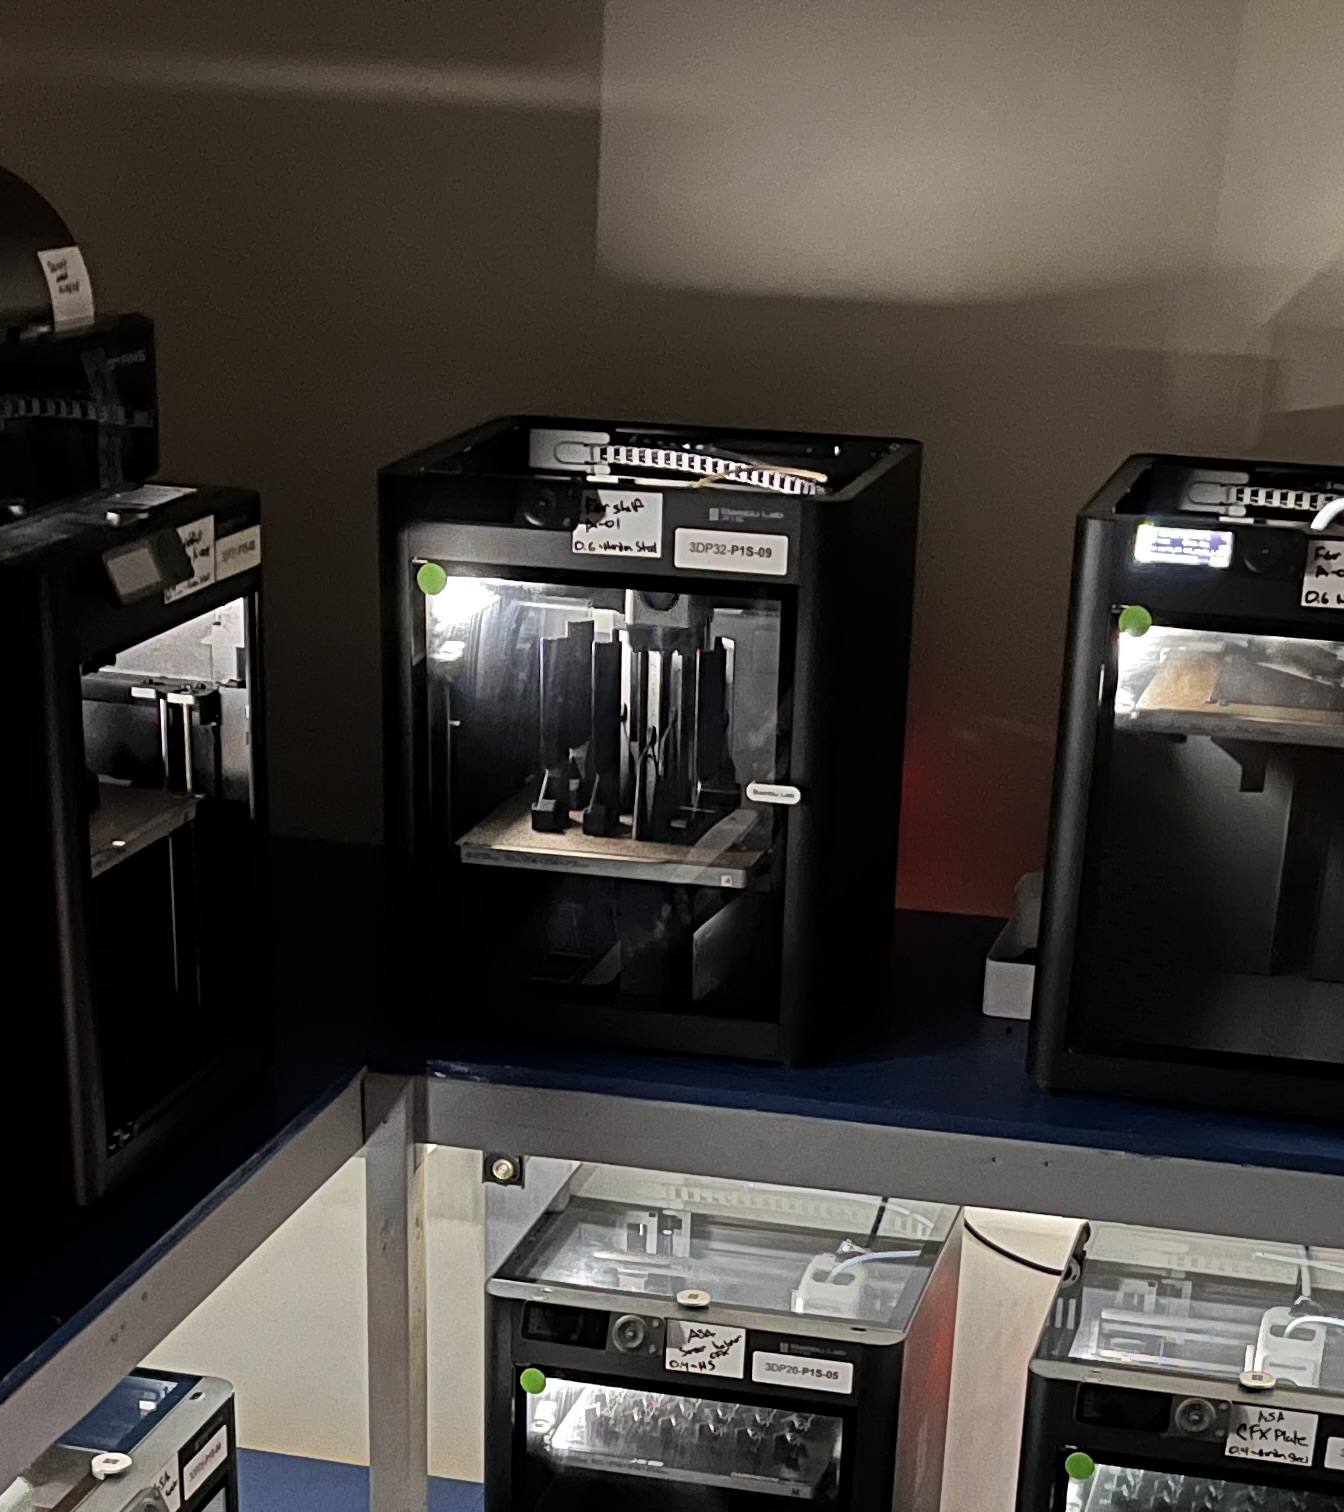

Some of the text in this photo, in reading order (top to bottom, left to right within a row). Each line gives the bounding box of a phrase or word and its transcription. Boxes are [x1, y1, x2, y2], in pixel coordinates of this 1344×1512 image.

[689, 541, 773, 558] 3DP32-P1S-09
[1257, 1410, 1286, 1424] ASA
[1236, 1423, 1272, 1442] CFX
